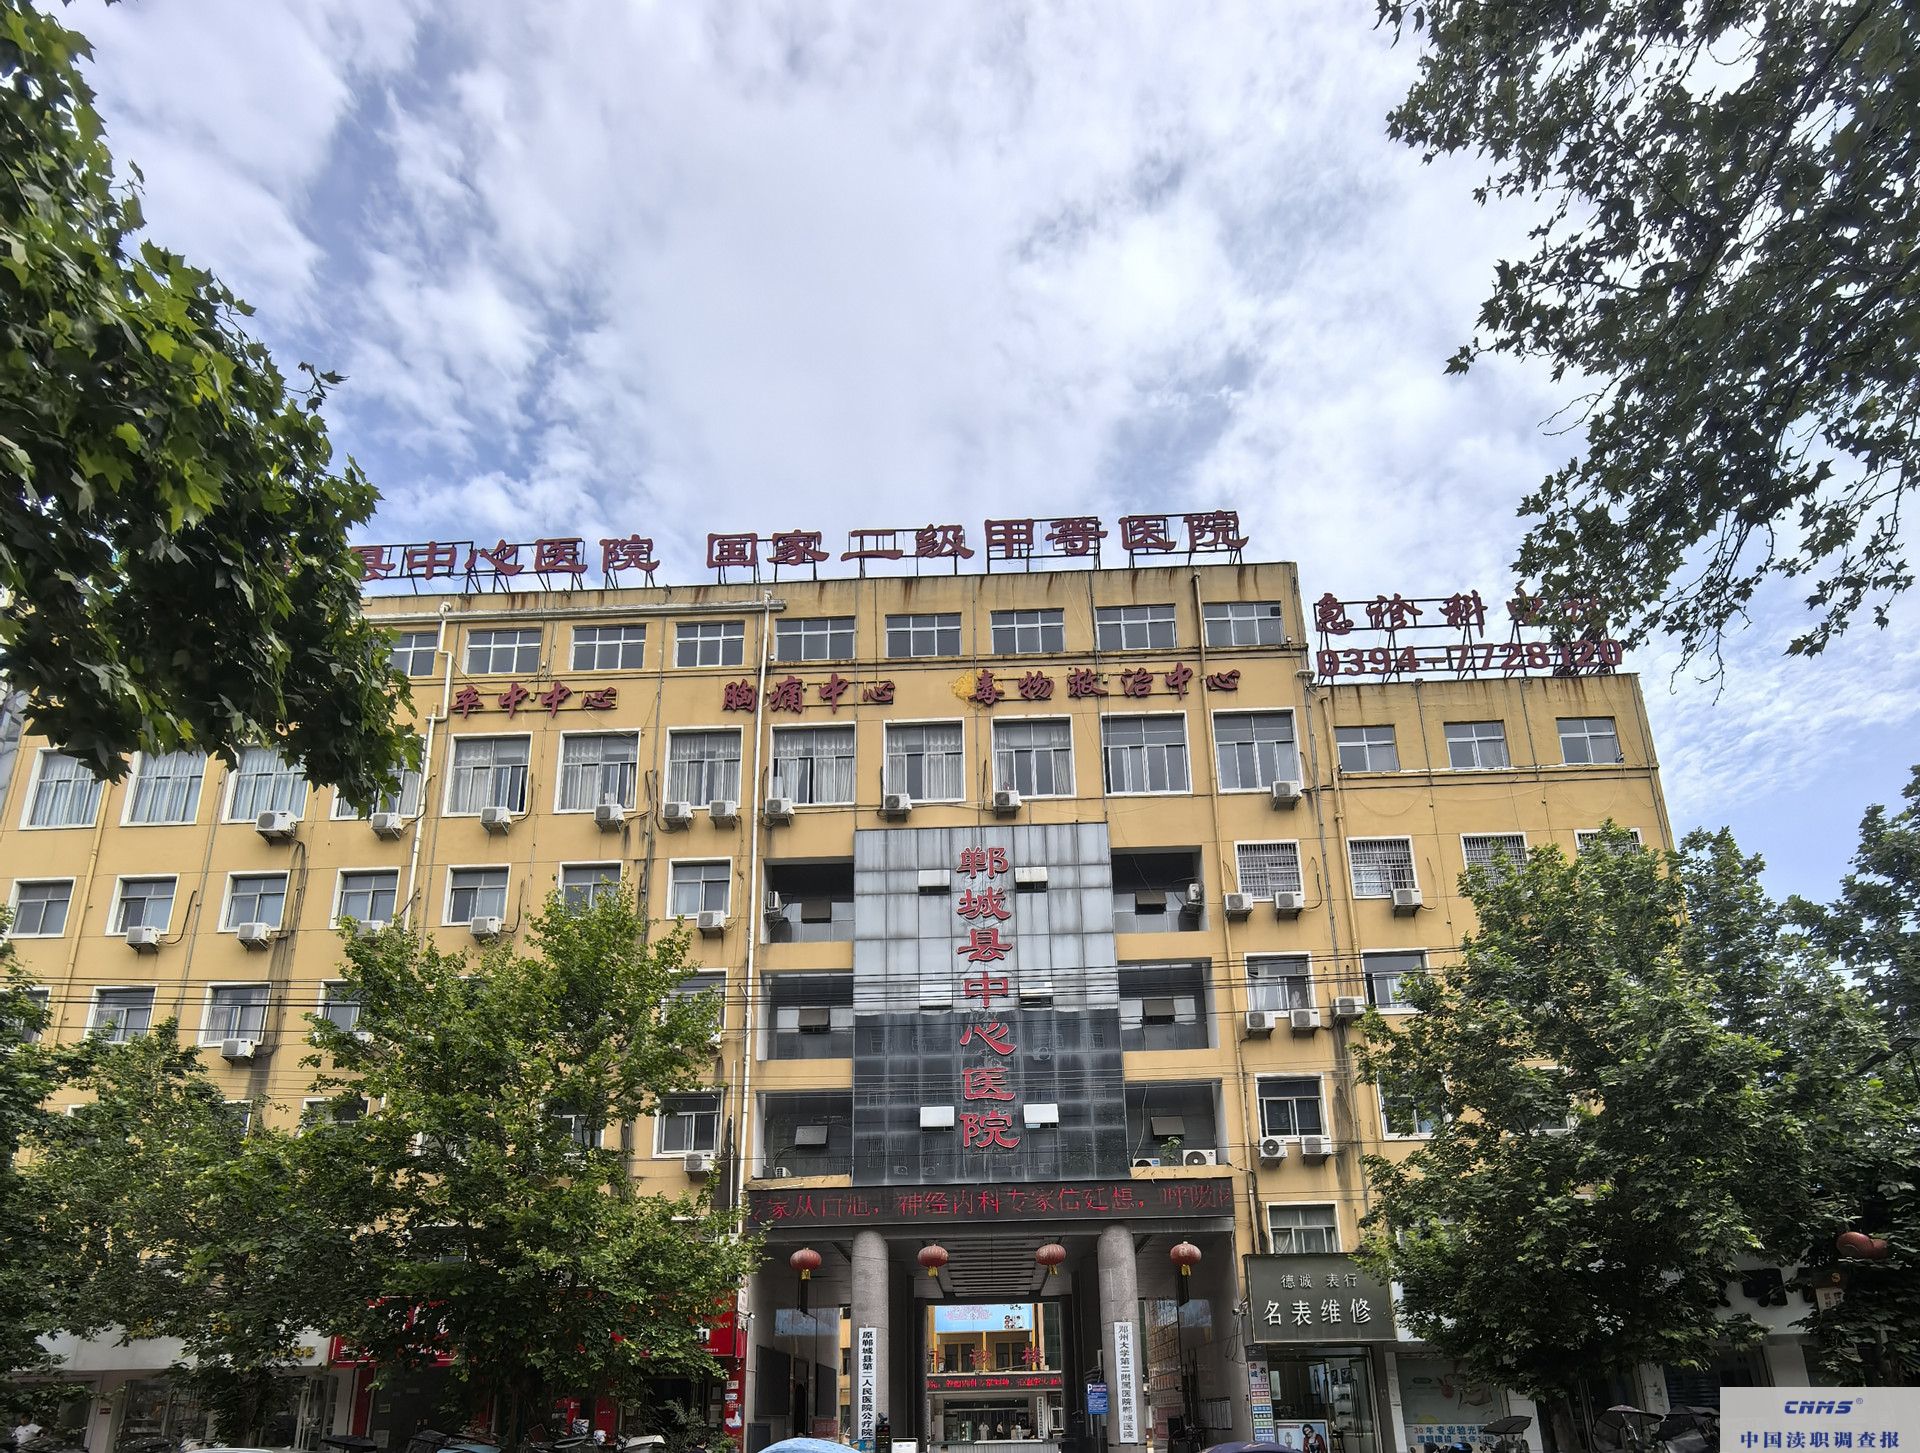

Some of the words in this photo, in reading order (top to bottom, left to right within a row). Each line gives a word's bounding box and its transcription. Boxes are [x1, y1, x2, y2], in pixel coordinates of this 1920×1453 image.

[706, 511, 1249, 569] 国家二级甲等医院
[450, 680, 618, 719] 卒中中心
[722, 672, 895, 714] 胸痛中心
[968, 661, 1241, 706] 毒物救治中心
[956, 846, 1021, 1149] 郸城县中心医院
[1280, 1273, 1314, 1289] 德诚
[1326, 1273, 1358, 1288] 表行
[1263, 1298, 1372, 1326] 名表维修
[861, 1331, 874, 1440] 原郸城县第二人民医院公疗院
